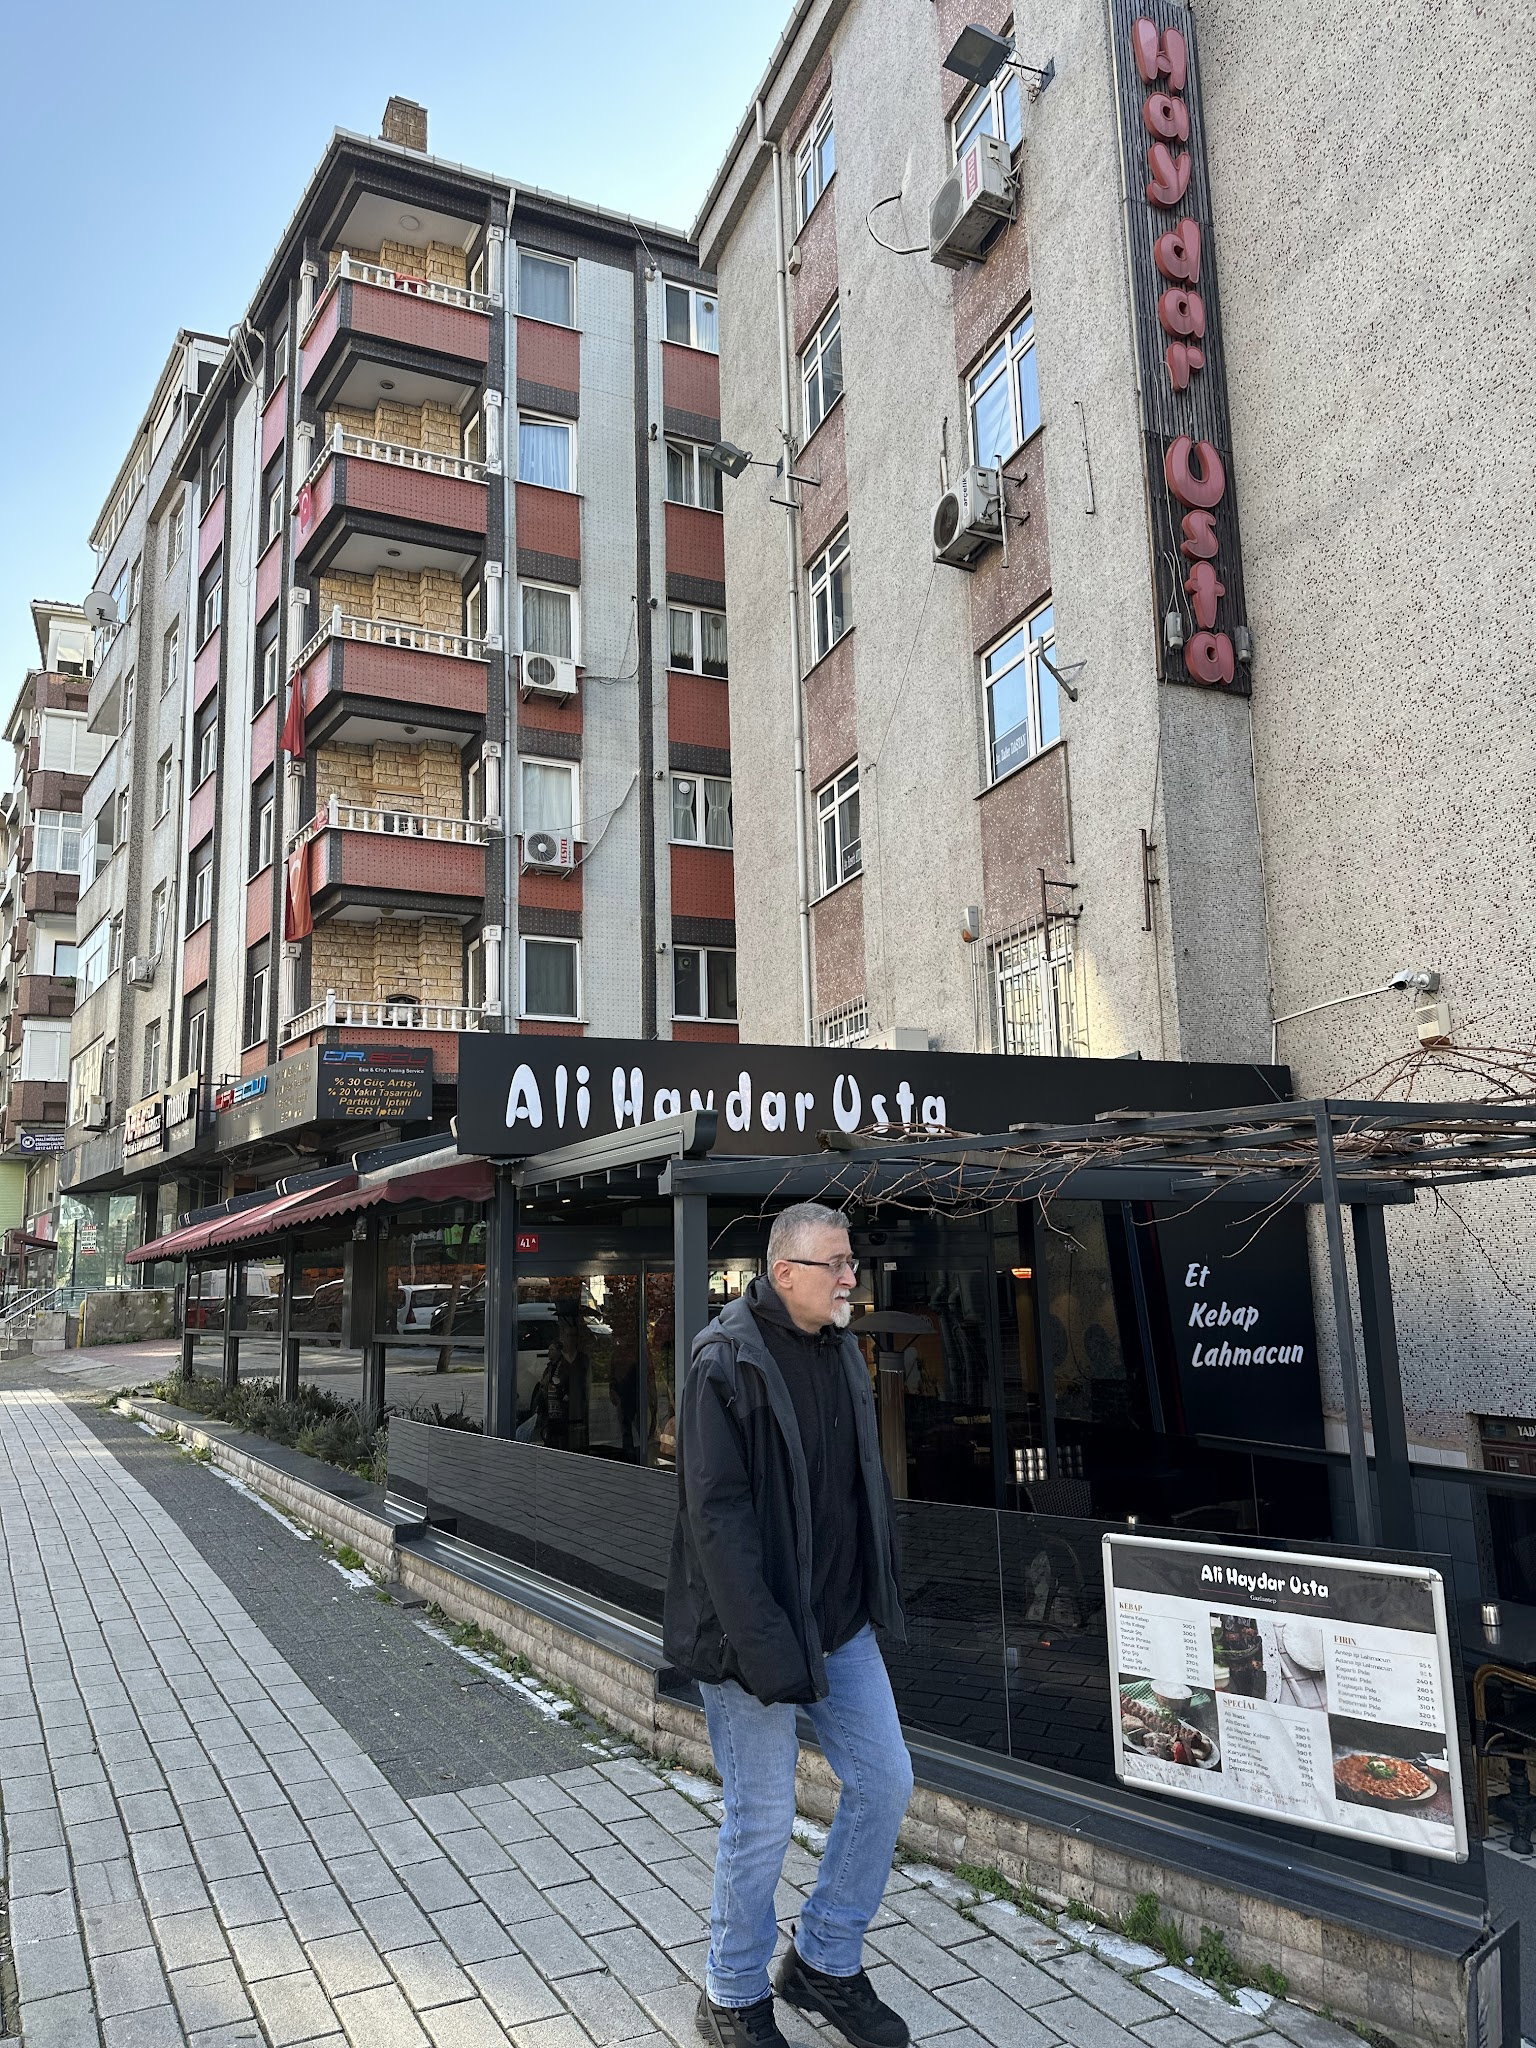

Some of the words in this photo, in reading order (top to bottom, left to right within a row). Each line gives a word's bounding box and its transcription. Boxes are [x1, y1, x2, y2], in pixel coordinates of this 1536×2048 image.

[1132, 17, 1205, 392] Haydar
[1166, 434, 1235, 685] Usta
[335, 1077, 344, 1085] %
[347, 1078, 360, 1086] 30
[363, 1078, 385, 1088] Güç
[387, 1079, 416, 1088] Artışı
[339, 1088, 350, 1096] 20
[380, 1089, 422, 1097] Tasarrufu
[339, 1097, 380, 1106] Partikül
[386, 1096, 411, 1107] İptali
[506, 1064, 591, 1129] Ali
[832, 1074, 946, 1134] Usta
[346, 1107, 373, 1115] EGR
[376, 1107, 404, 1117] İptali
[1184, 1262, 1210, 1288] Et
[1188, 1301, 1259, 1332] Kebap
[1191, 1341, 1304, 1368] Lahmacun
[1201, 1565, 1222, 1583] Ali
[1226, 1567, 1286, 1592] Haydar
[1289, 1576, 1329, 1598] Usta
[1120, 1602, 1142, 1611] KEBAP
[1334, 1635, 1356, 1645] FIRIN
[1223, 1699, 1257, 1710] SPECİAL
